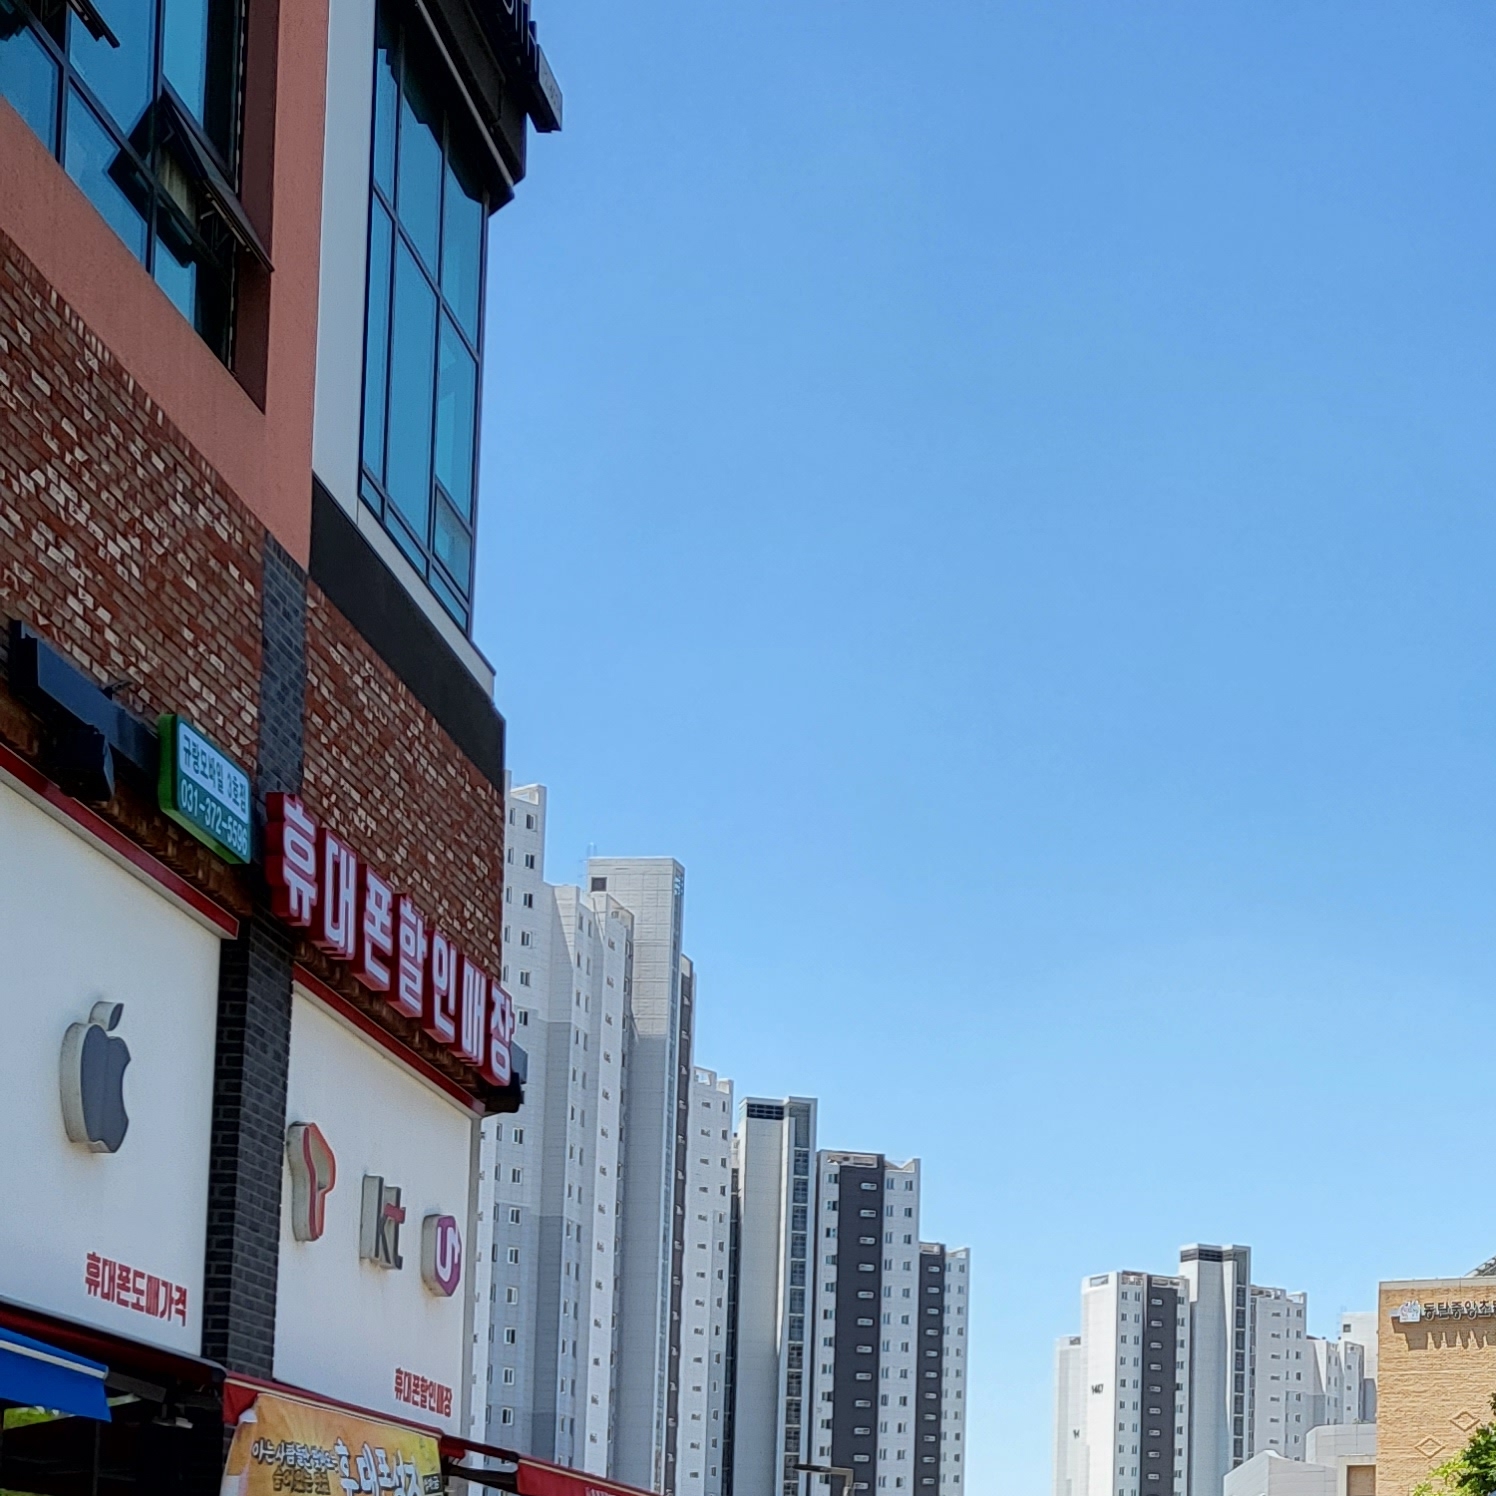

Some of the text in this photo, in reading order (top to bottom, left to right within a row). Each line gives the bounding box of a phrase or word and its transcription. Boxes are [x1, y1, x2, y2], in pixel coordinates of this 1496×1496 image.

[180, 778, 248, 856] 031-372-5596
[282, 794, 515, 1086] 휴대폰할인매장
[85, 1251, 187, 1327] 휴대폰도매가격
[394, 1366, 452, 1418] 휴대폰할인매장
